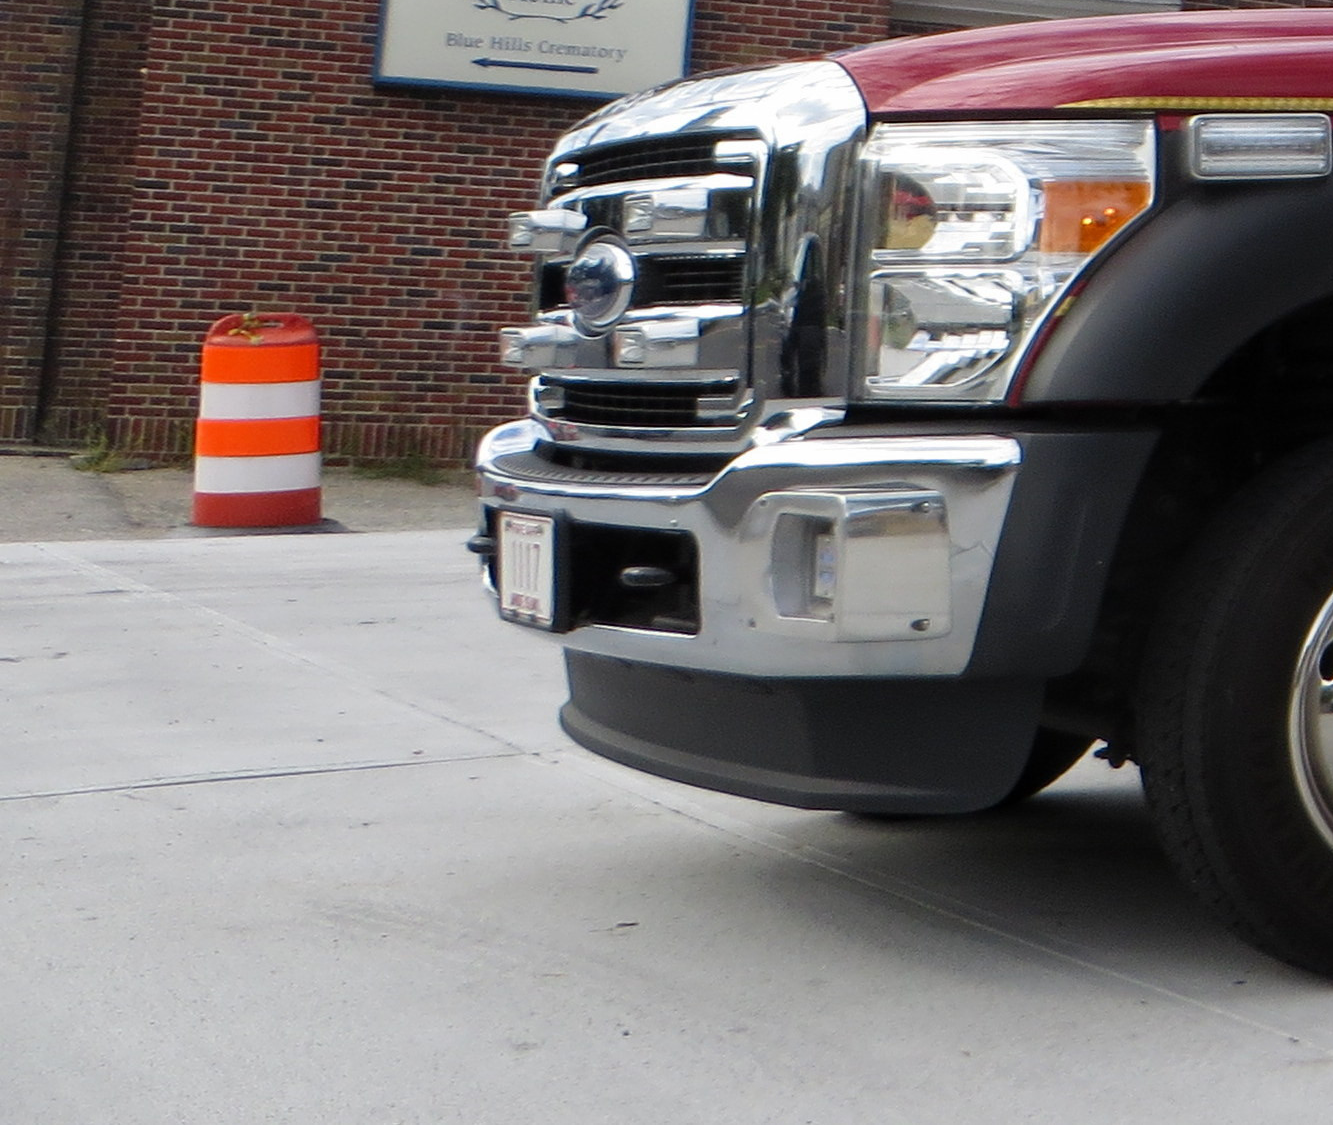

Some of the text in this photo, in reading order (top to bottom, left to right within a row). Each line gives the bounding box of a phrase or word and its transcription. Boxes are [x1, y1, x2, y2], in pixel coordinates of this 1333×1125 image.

[445, 32, 628, 62] Blue Hills Crematory
